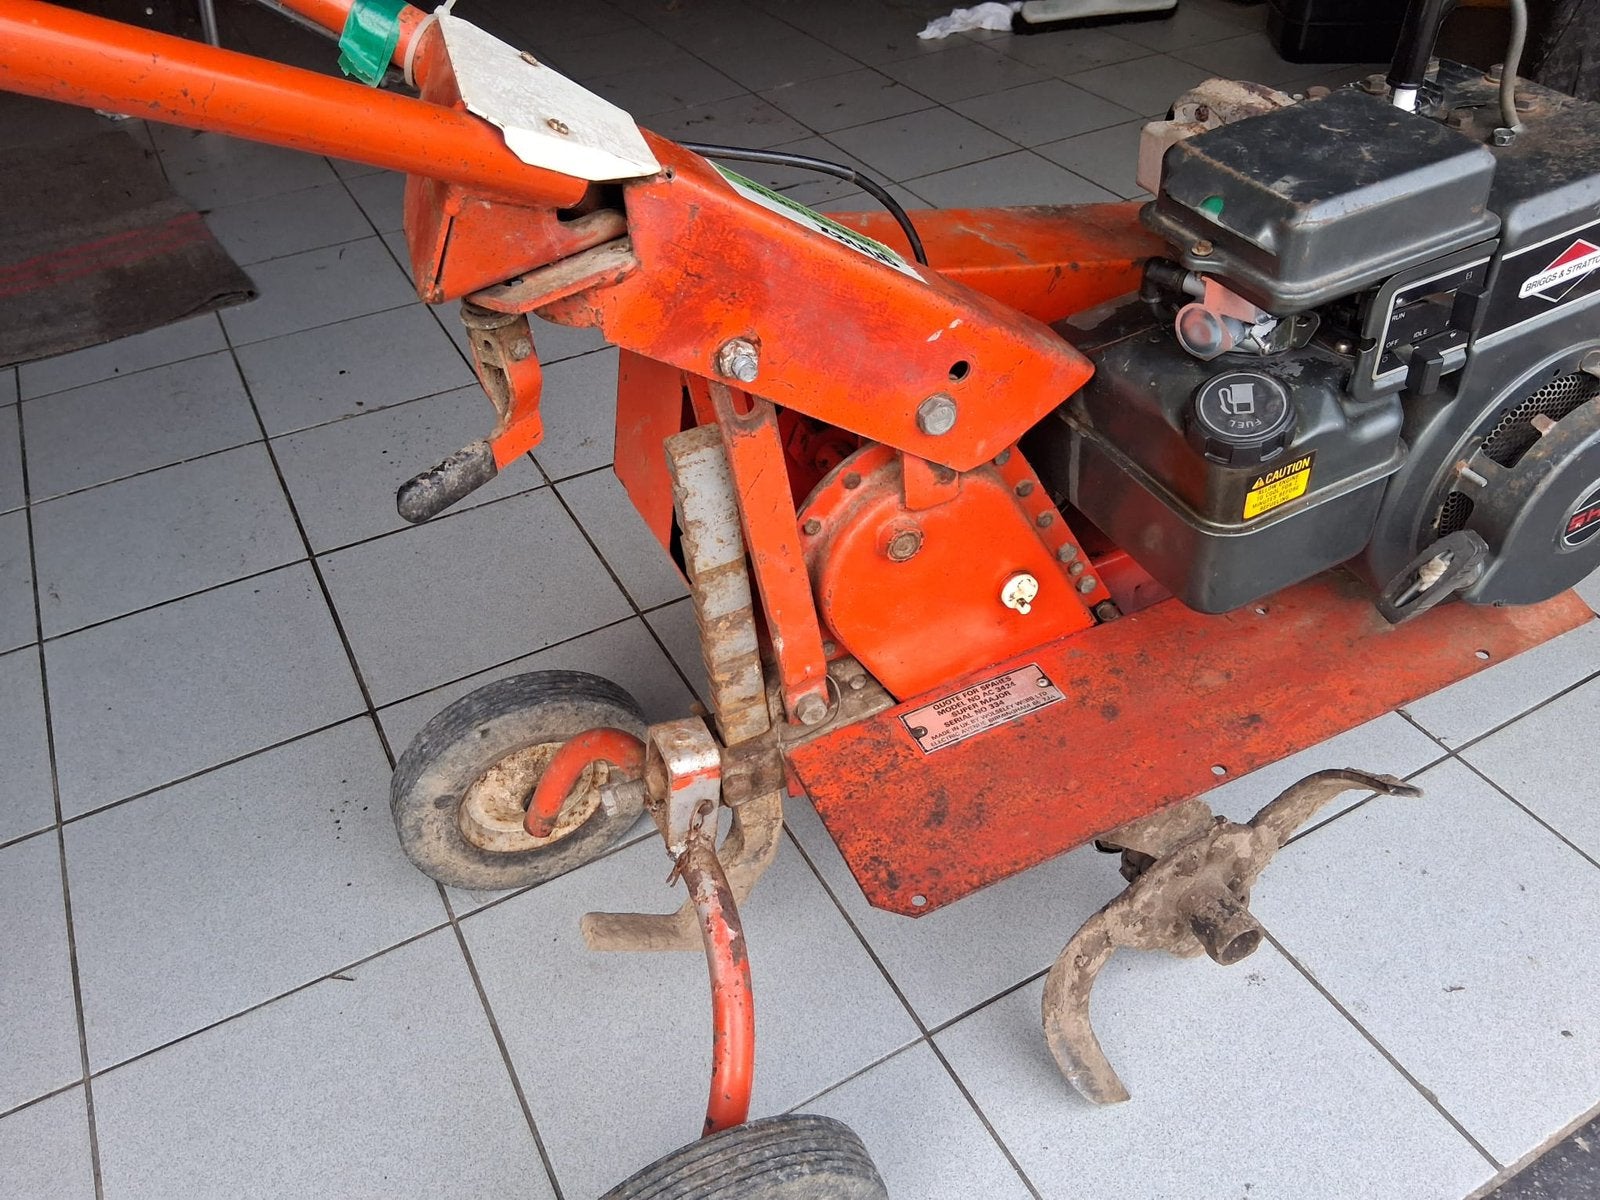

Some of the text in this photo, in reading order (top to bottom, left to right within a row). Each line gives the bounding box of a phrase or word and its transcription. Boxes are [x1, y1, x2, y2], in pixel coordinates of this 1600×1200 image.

[1525, 272, 1557, 292] BRIGGS
[1558, 269, 1565, 279] &
[1392, 311, 1406, 322] RUN
[1385, 338, 1400, 349] OFF
[1413, 328, 1428, 339] IDLE
[1229, 418, 1262, 429] FUEL
[1265, 456, 1311, 484] CAUTION
[933, 676, 1012, 711] QUOTE FOR SPARES
[937, 681, 1017, 717] MODEL NO AC 3424
[951, 690, 1012, 718] SUPER MAJOR
[930, 733, 960, 747] ELECTRIC
[961, 720, 988, 734] AVENUE
[988, 703, 1031, 723] BIRMINGHAM
[931, 728, 951, 741] MADE
[951, 725, 960, 733] IN
[960, 721, 970, 729] UK
[980, 703, 1014, 720] WOLSELEY
[1035, 691, 1048, 699] LTD
[943, 700, 1005, 728] SERIAL NO 334
